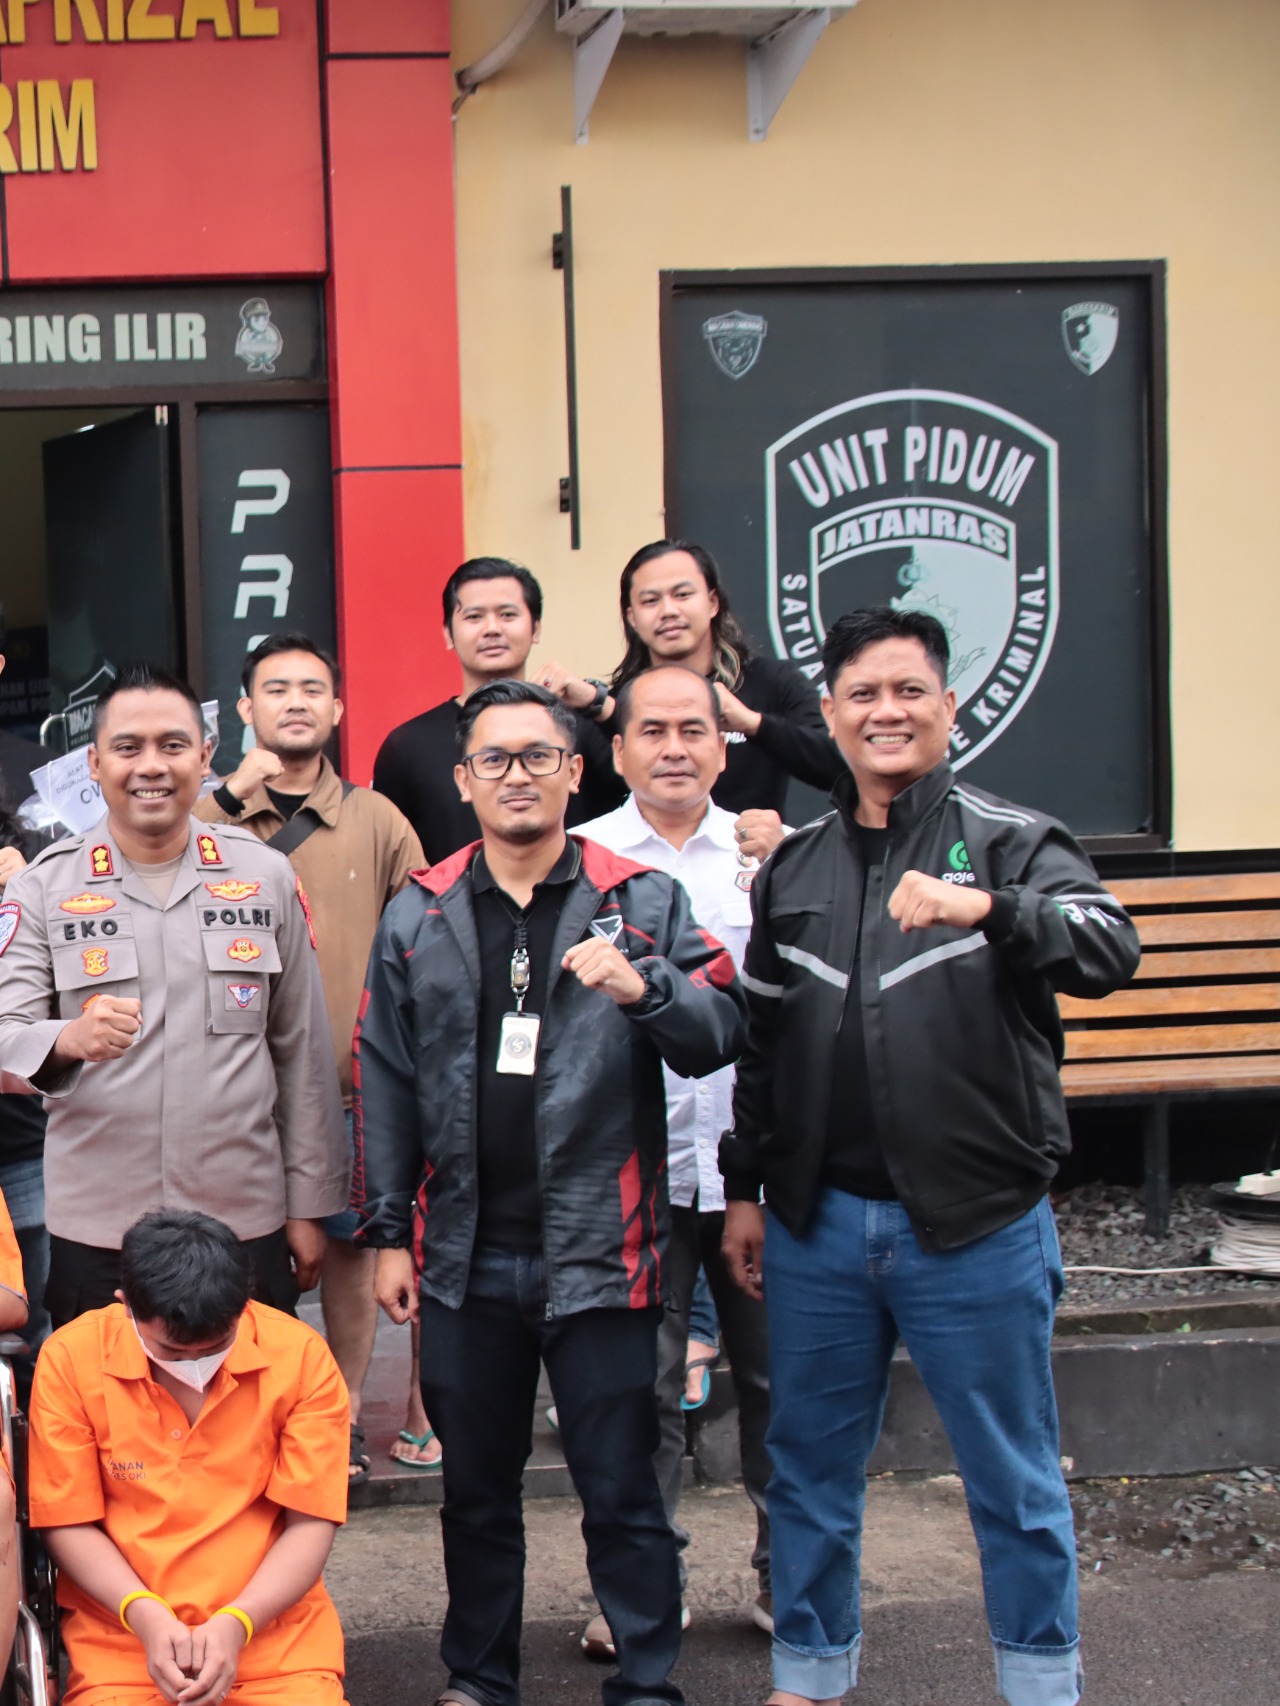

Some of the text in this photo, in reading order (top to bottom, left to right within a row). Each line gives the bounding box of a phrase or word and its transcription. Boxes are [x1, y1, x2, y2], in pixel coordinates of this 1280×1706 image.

[114, 312, 207, 362] ILIR
[788, 426, 1036, 509] UNIT PIDUM
[819, 507, 1008, 560] JATANRAS
[971, 565, 1045, 726] KRIMINAL
[64, 919, 118, 940] EKO
[203, 908, 270, 927] POLRI
